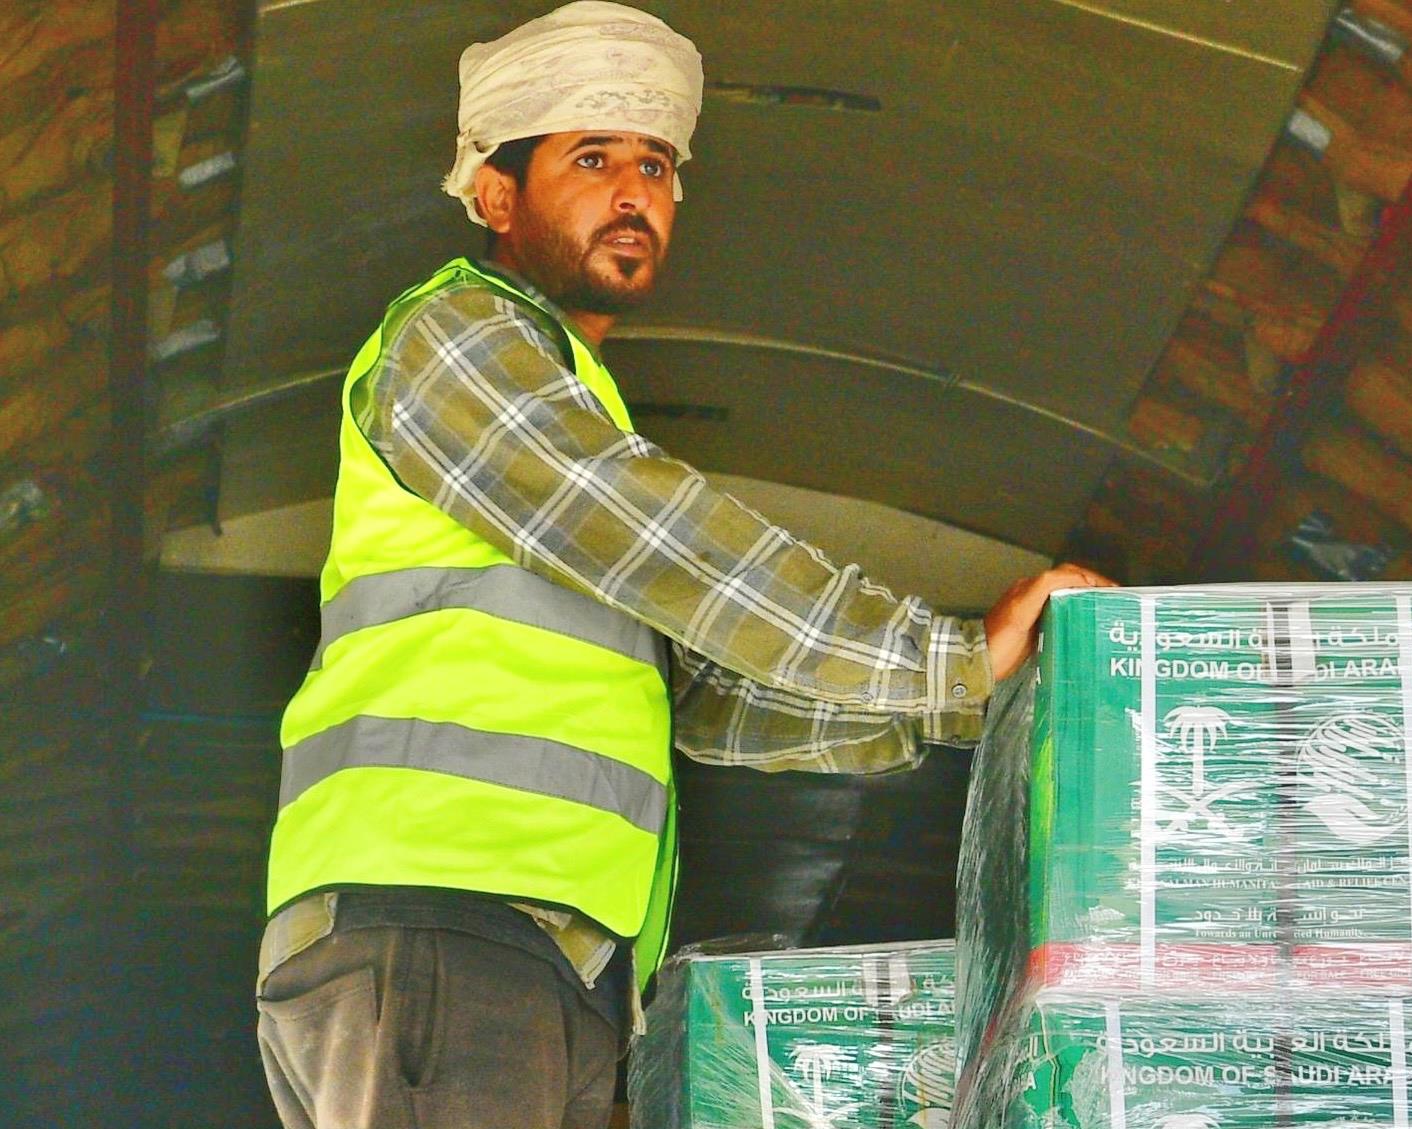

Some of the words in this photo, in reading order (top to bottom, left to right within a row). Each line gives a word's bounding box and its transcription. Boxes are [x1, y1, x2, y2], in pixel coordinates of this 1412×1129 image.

[1110, 657, 1229, 681] KIGDOM
[744, 1006, 840, 1026] KNGDOM
[1222, 1065, 1257, 1087] OF
